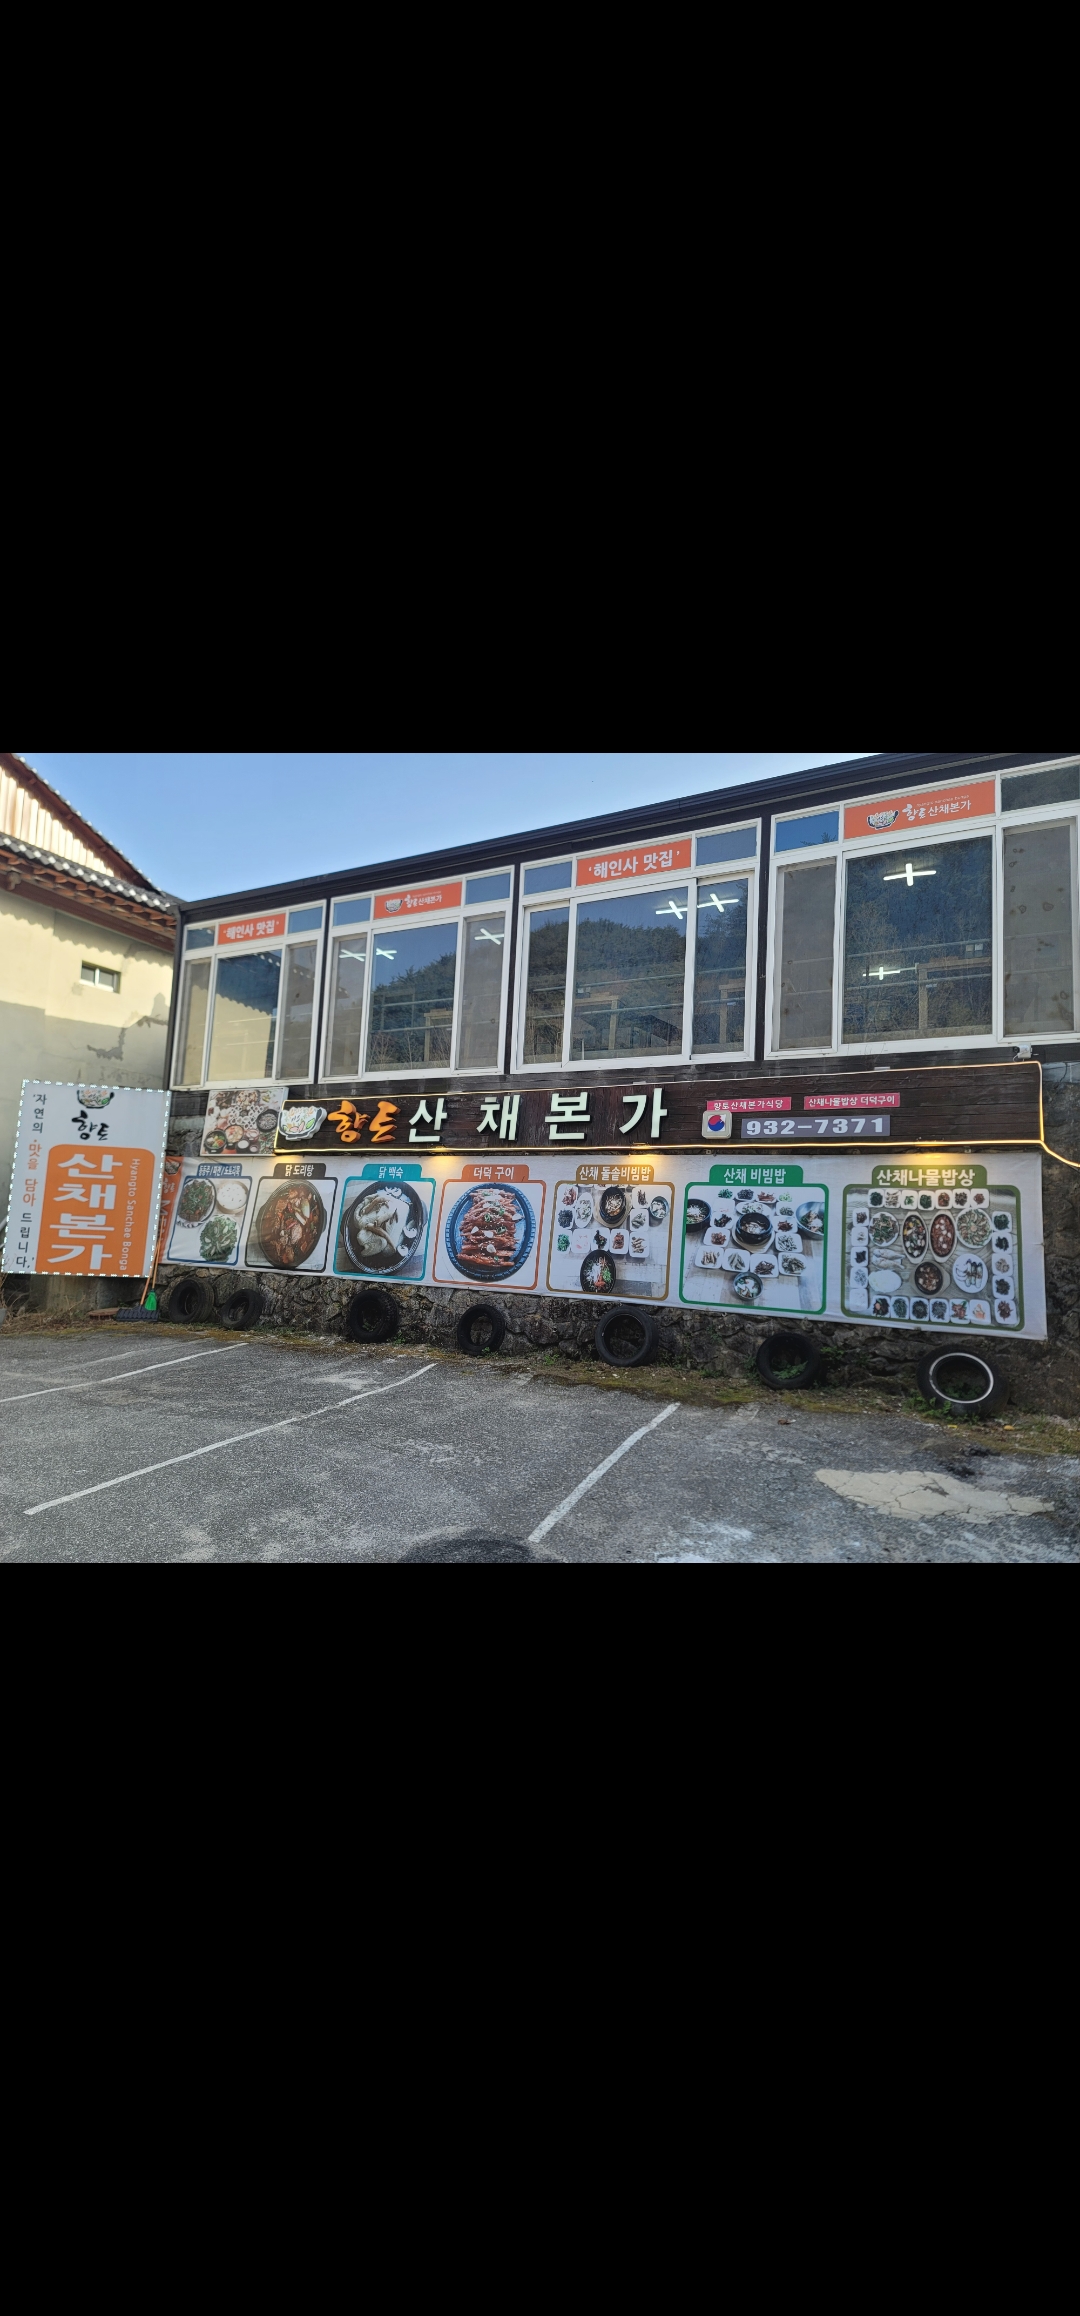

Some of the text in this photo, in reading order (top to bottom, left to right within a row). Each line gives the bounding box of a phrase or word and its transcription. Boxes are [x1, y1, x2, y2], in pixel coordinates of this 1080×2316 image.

[927, 799, 972, 818] 산채본가
[808, 1094, 896, 1107] 산채나물밥상 더덕구이
[71, 1110, 110, 1141] 향토
[327, 1100, 401, 1143] 향토
[746, 1117, 884, 1136] 932-7371
[293, 1164, 315, 1177] 도리탕
[378, 1166, 404, 1179] 닭 백숙
[473, 1167, 515, 1180] 더덕 구이
[579, 1166, 651, 1182] 산채 돌솥비빔밥
[723, 1168, 786, 1184] 산채 비빔밥
[876, 1168, 976, 1187] 산채나물밥상
[23, 1178, 38, 1207] 담아
[47, 1153, 123, 1271] 산채본가
[119, 1158, 141, 1271] Hyangto Sanchae Bonga
